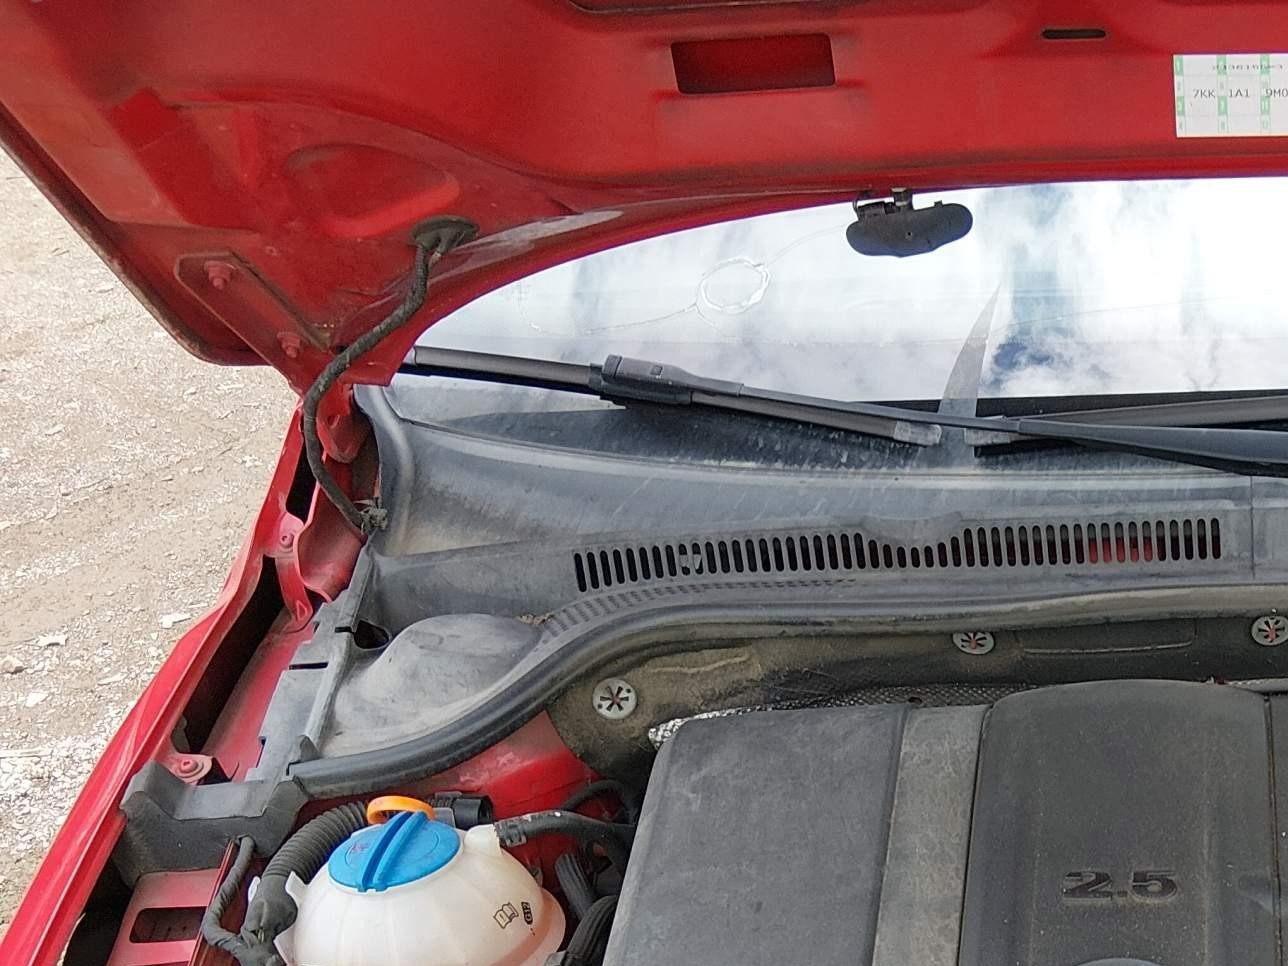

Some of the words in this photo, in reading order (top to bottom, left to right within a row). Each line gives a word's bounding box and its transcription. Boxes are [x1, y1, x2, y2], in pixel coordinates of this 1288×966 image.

[1193, 88, 1216, 99] 7KK
[1228, 88, 1250, 98] 1A1
[1265, 87, 1288, 98] 9M0
[1062, 870, 1178, 900] 2.5
